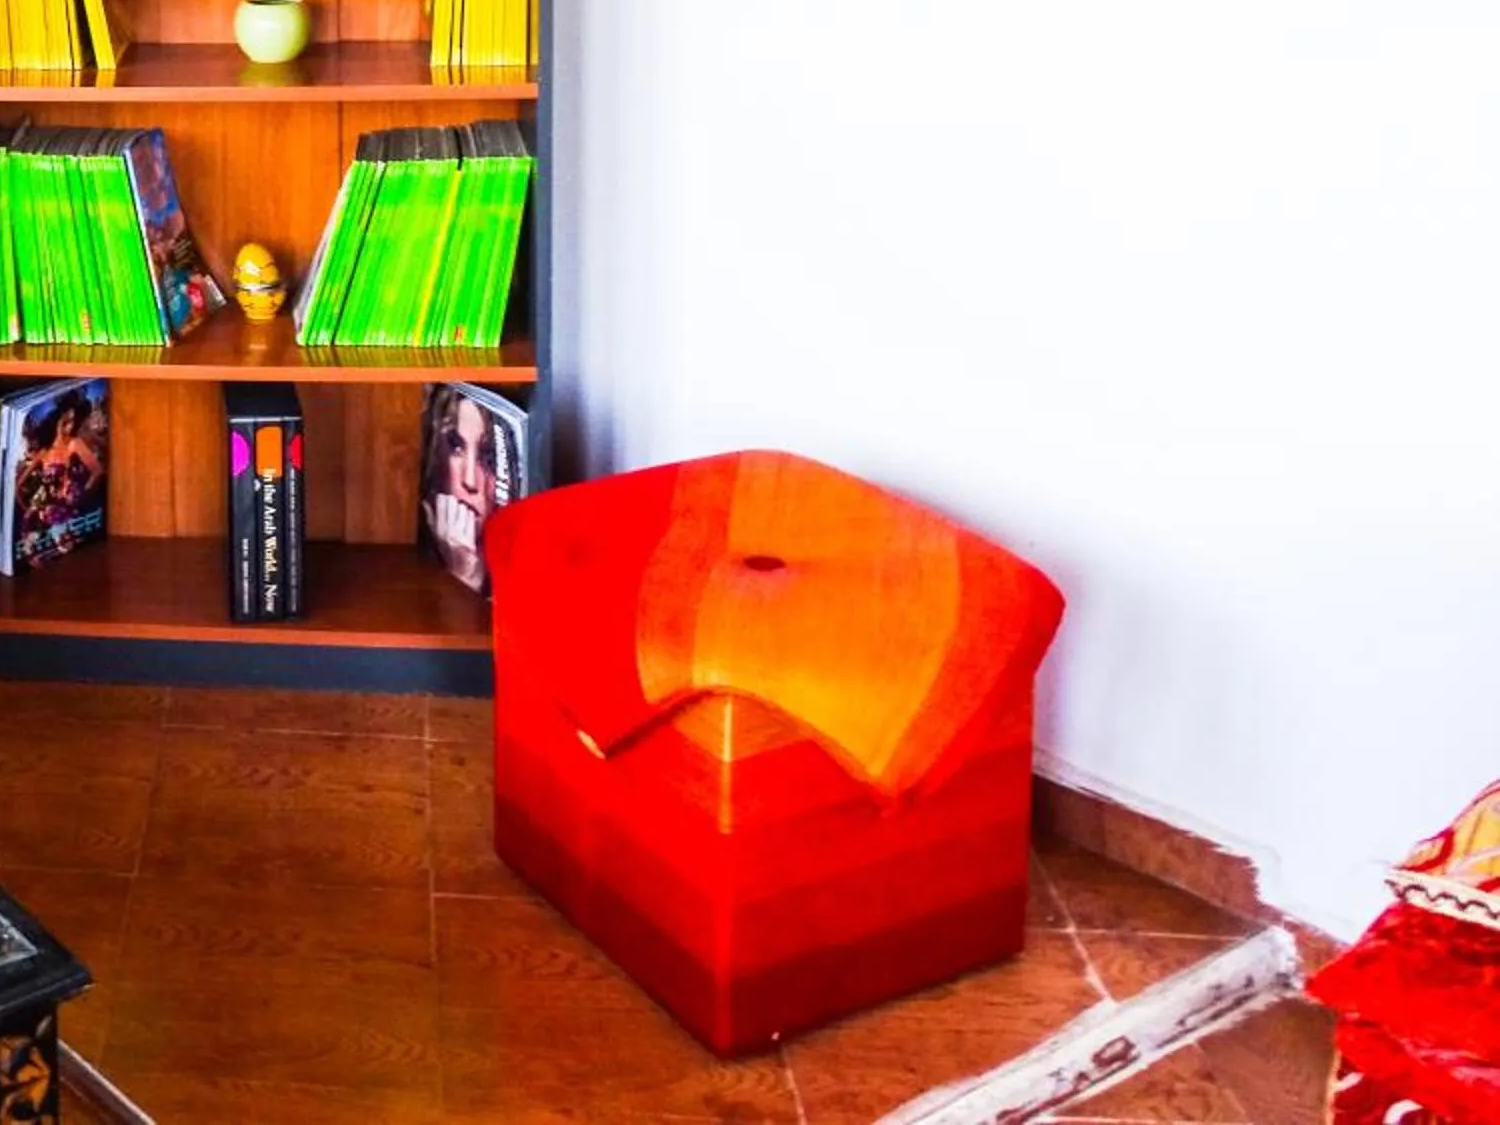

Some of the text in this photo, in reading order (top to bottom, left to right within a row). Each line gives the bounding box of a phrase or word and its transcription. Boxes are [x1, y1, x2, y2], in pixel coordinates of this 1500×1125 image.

[263, 484, 277, 504] the
[263, 506, 277, 535] Arab
[264, 584, 277, 612] Now
